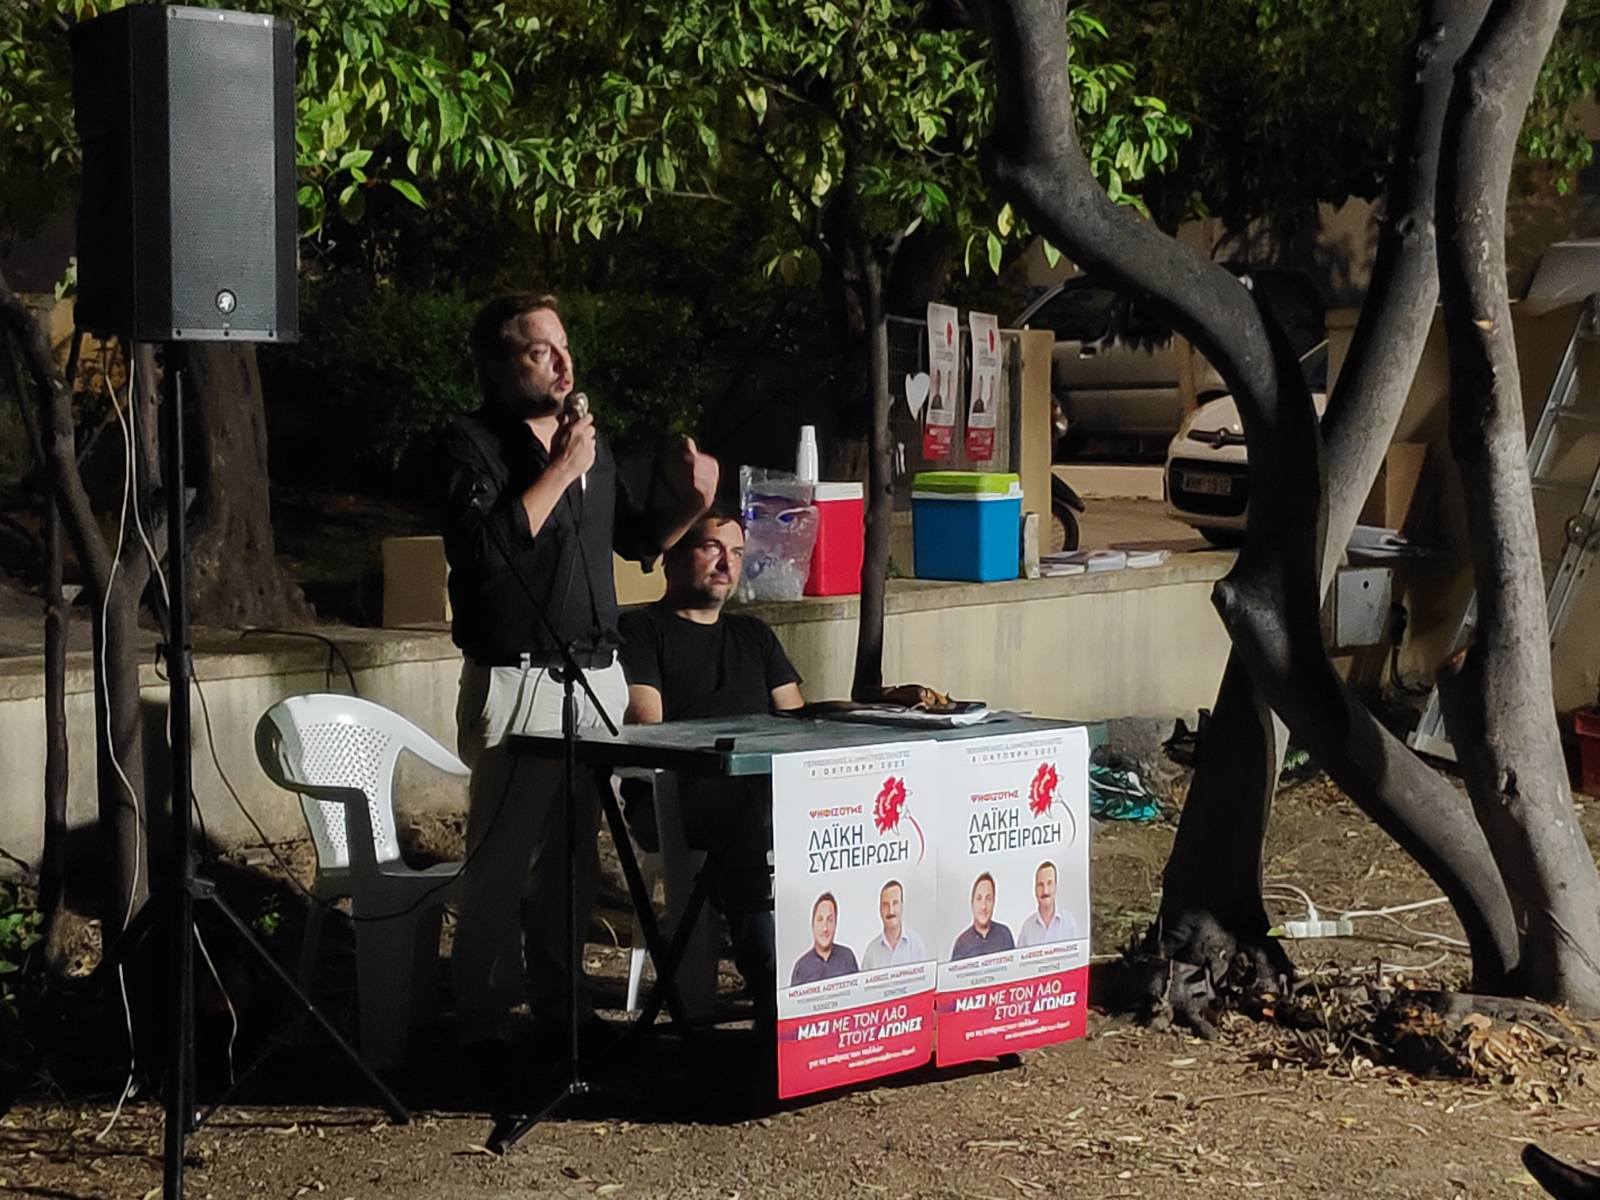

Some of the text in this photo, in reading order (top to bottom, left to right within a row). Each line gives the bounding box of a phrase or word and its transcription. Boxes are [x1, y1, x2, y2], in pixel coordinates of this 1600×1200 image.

[969, 807, 1019, 833] ΛΑΪΚΗ
[809, 823, 863, 851] ΛΑΪΚΗ
[969, 823, 1061, 854] ΣΥΣΠΕΙΡΩΣΗ
[809, 840, 909, 873] ΣΥΣΠΕΙΡΩΣΗ
[955, 980, 1062, 1013] ΜΑΖΙ ΜΕ ΤΟΝ ΛΑΟ
[994, 992, 1077, 1020] ΣΤΟΥΣ ΑΓΩΝΕΣ
[798, 1005, 907, 1040] ΜΑΖΙ ΜΕ ΤΟΝ ΛΑΟ
[839, 1017, 923, 1048] ΣΤΟΥΣ ΑΓΩΝΕΣ
